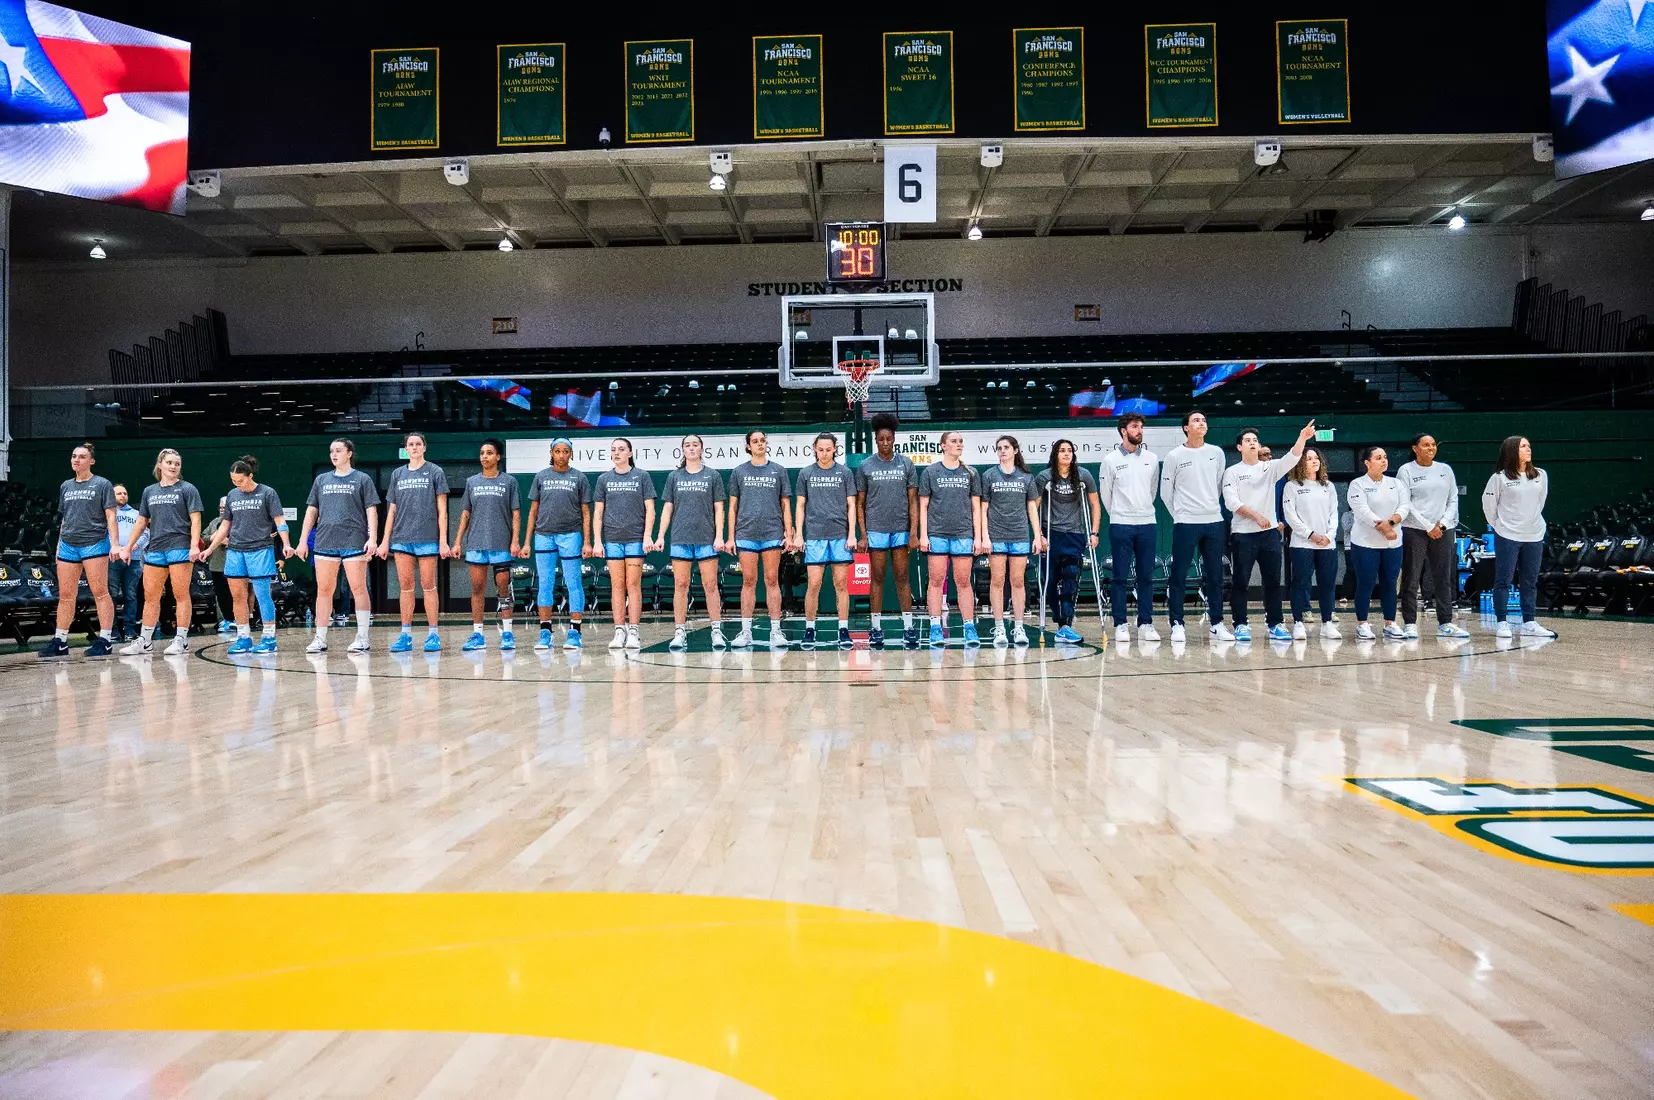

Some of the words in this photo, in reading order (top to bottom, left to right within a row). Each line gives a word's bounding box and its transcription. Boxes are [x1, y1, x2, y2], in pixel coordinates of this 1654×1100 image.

[1157, 37, 1205, 49] FRANCISCO
[1288, 33, 1336, 46] FRANCISCO
[895, 45, 941, 56] FRANCISCO
[1025, 41, 1072, 53] FRANCISCO
[636, 53, 682, 65] FRANCISCO
[765, 48, 811, 60] FRANCISCO
[382, 62, 428, 73] FRANCISCO
[508, 57, 554, 69] FRANCISCO
[632, 81, 687, 89] TOURNAMENT
[898, 164, 922, 202] 6
[839, 230, 878, 245] 10:00
[841, 248, 873, 276] 30
[748, 282, 838, 296] STUDENT
[876, 278, 962, 293] SECTION
[704, 446, 739, 458] SAN
[894, 442, 943, 454] RANCISC
[910, 455, 932, 464] ONS
